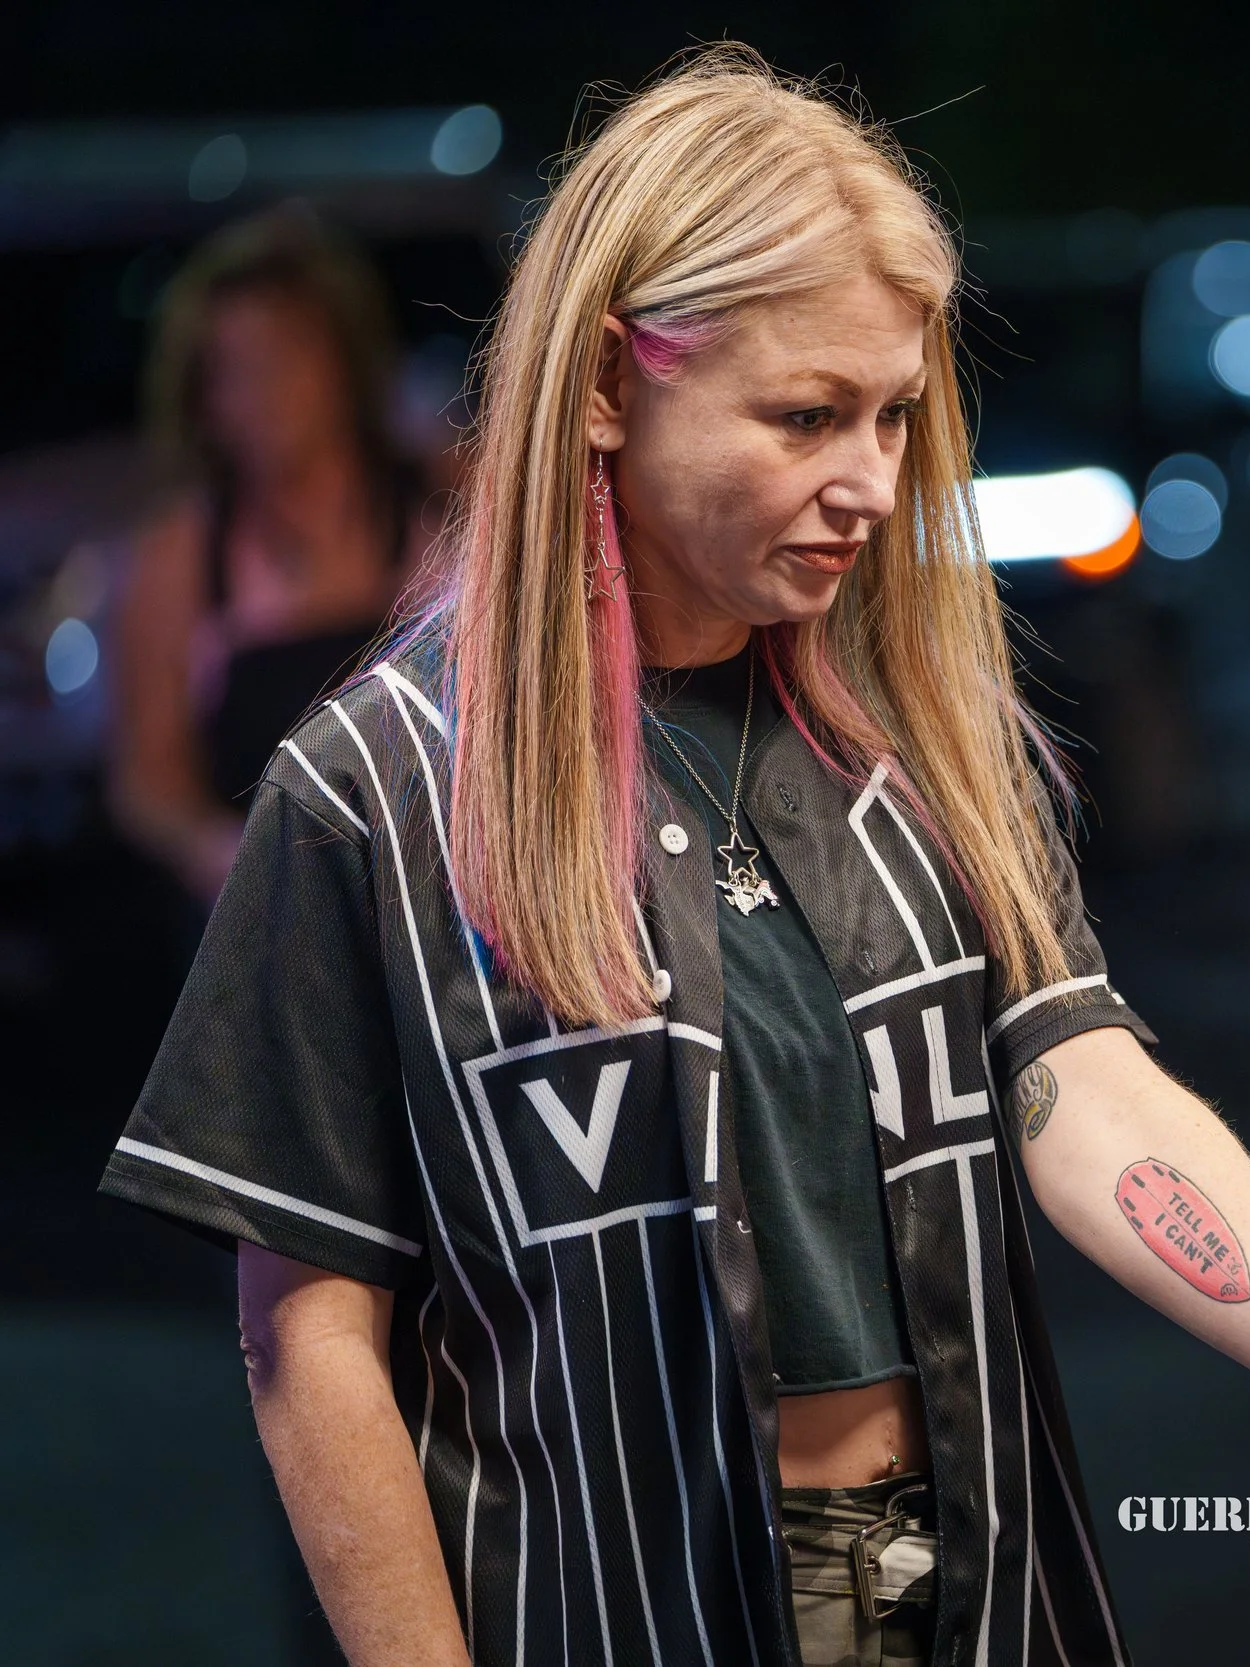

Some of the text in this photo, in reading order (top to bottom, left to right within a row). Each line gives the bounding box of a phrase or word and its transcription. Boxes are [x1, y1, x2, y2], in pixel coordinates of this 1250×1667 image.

[1154, 1212, 1213, 1274] I CAN'T
[1168, 1191, 1230, 1263] TELL ME
